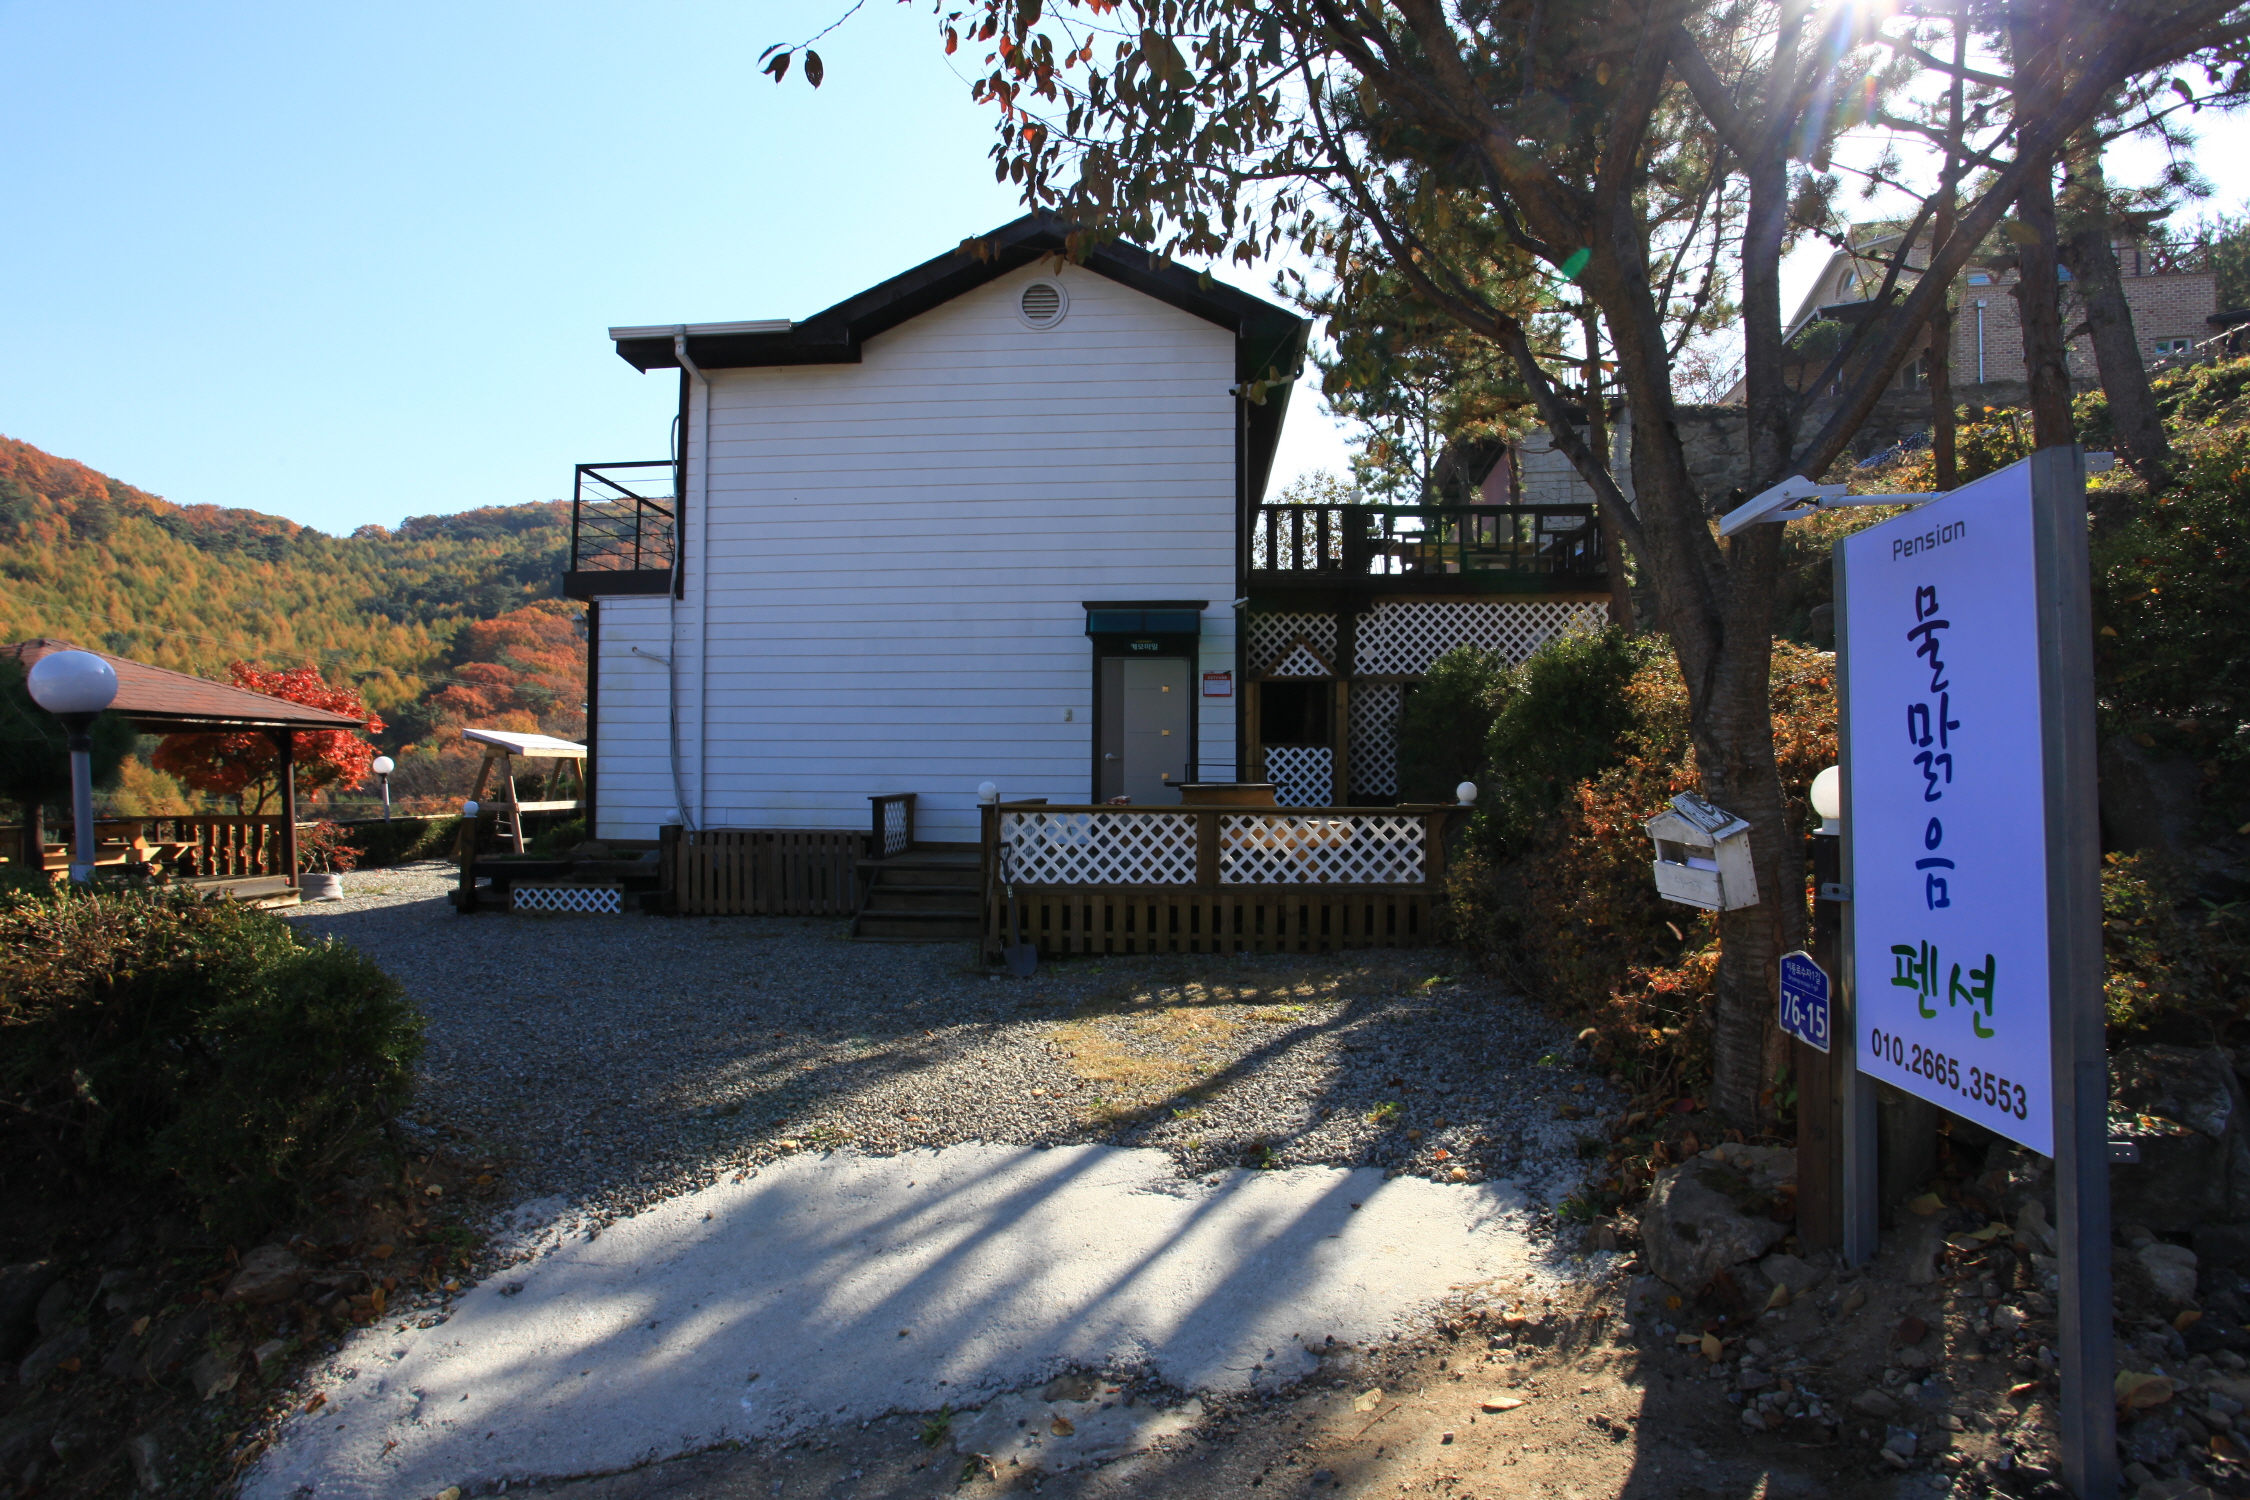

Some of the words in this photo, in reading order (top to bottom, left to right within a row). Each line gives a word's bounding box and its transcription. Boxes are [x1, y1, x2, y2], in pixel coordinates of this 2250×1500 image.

[1892, 520, 1965, 562] Pension
[1906, 585, 1960, 911] 물맑음
[1783, 990, 1826, 1039] 76-15
[1890, 939, 1996, 1039] 펜션
[1871, 1028, 2028, 1121] 010.2665.3553
